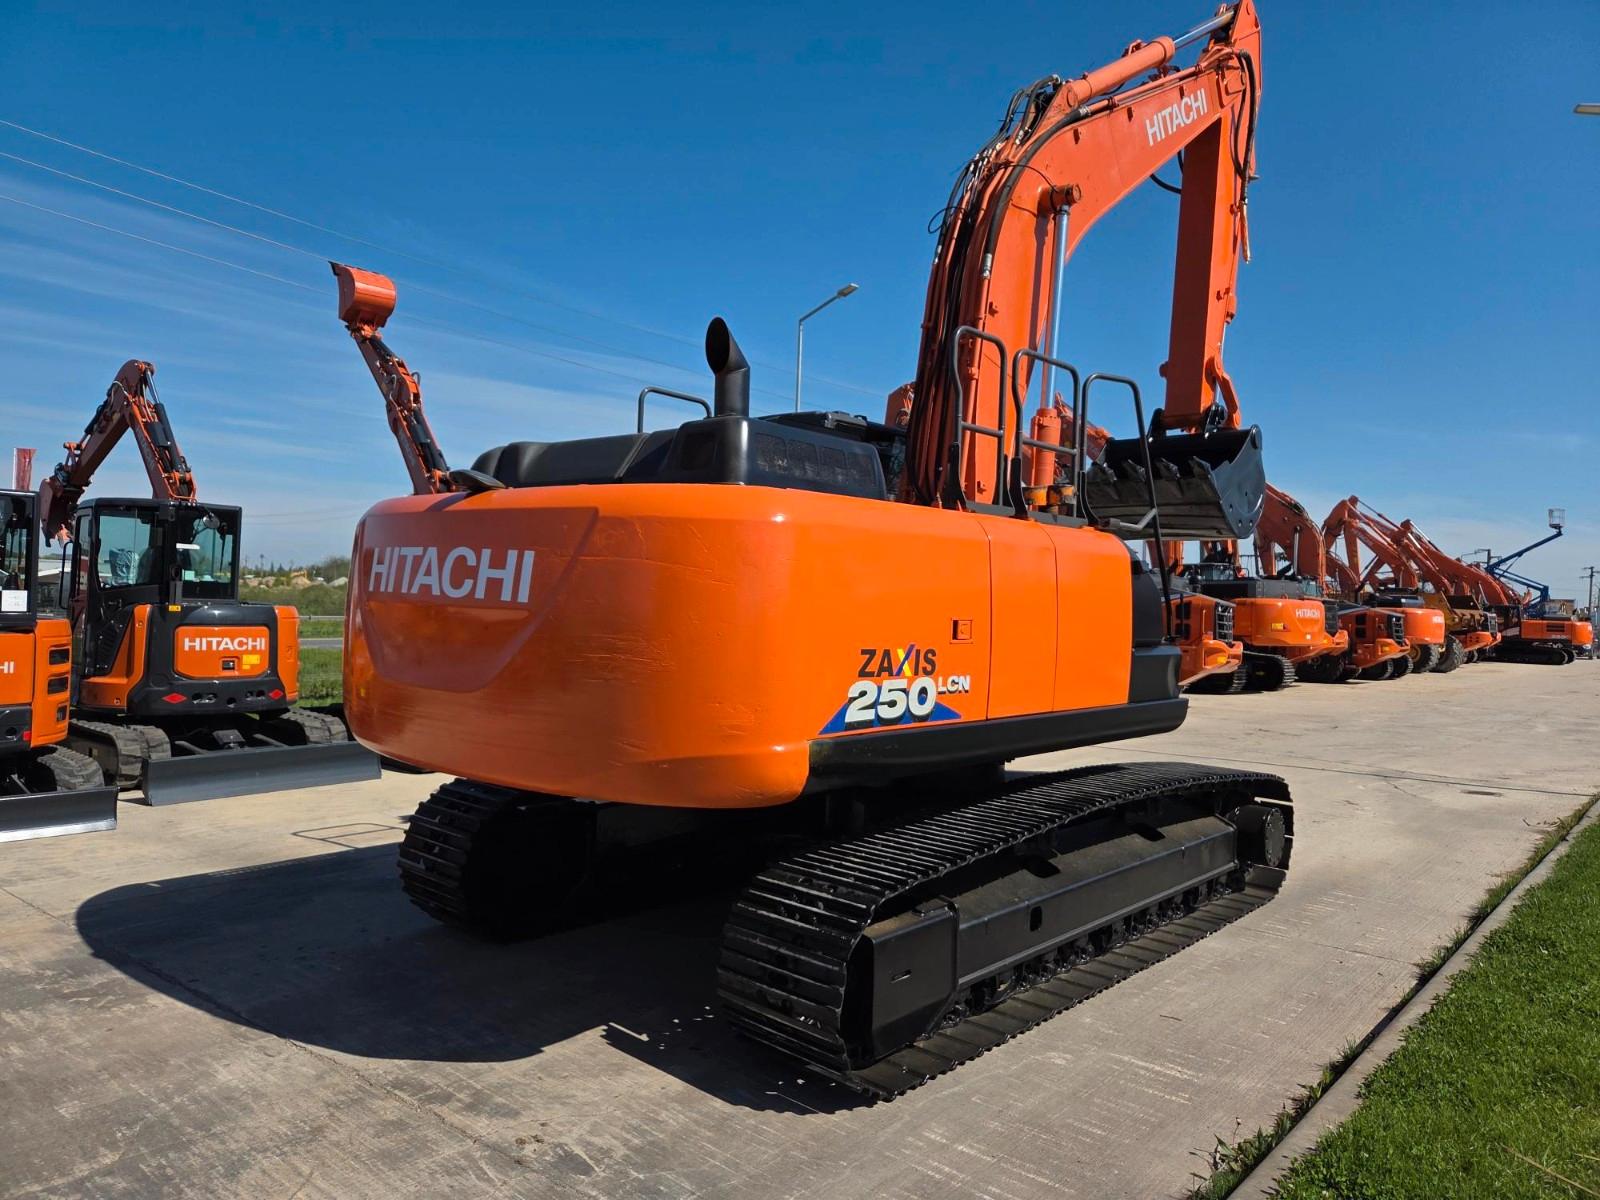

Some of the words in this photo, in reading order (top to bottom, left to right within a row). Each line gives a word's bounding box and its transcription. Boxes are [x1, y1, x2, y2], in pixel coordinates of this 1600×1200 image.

[1145, 88, 1208, 146] HITACHI
[368, 546, 535, 603] HITACHI
[183, 637, 265, 652] HITACHI
[858, 644, 937, 678] ZAXIS
[845, 677, 937, 727] 250
[937, 675, 971, 694] LCN
